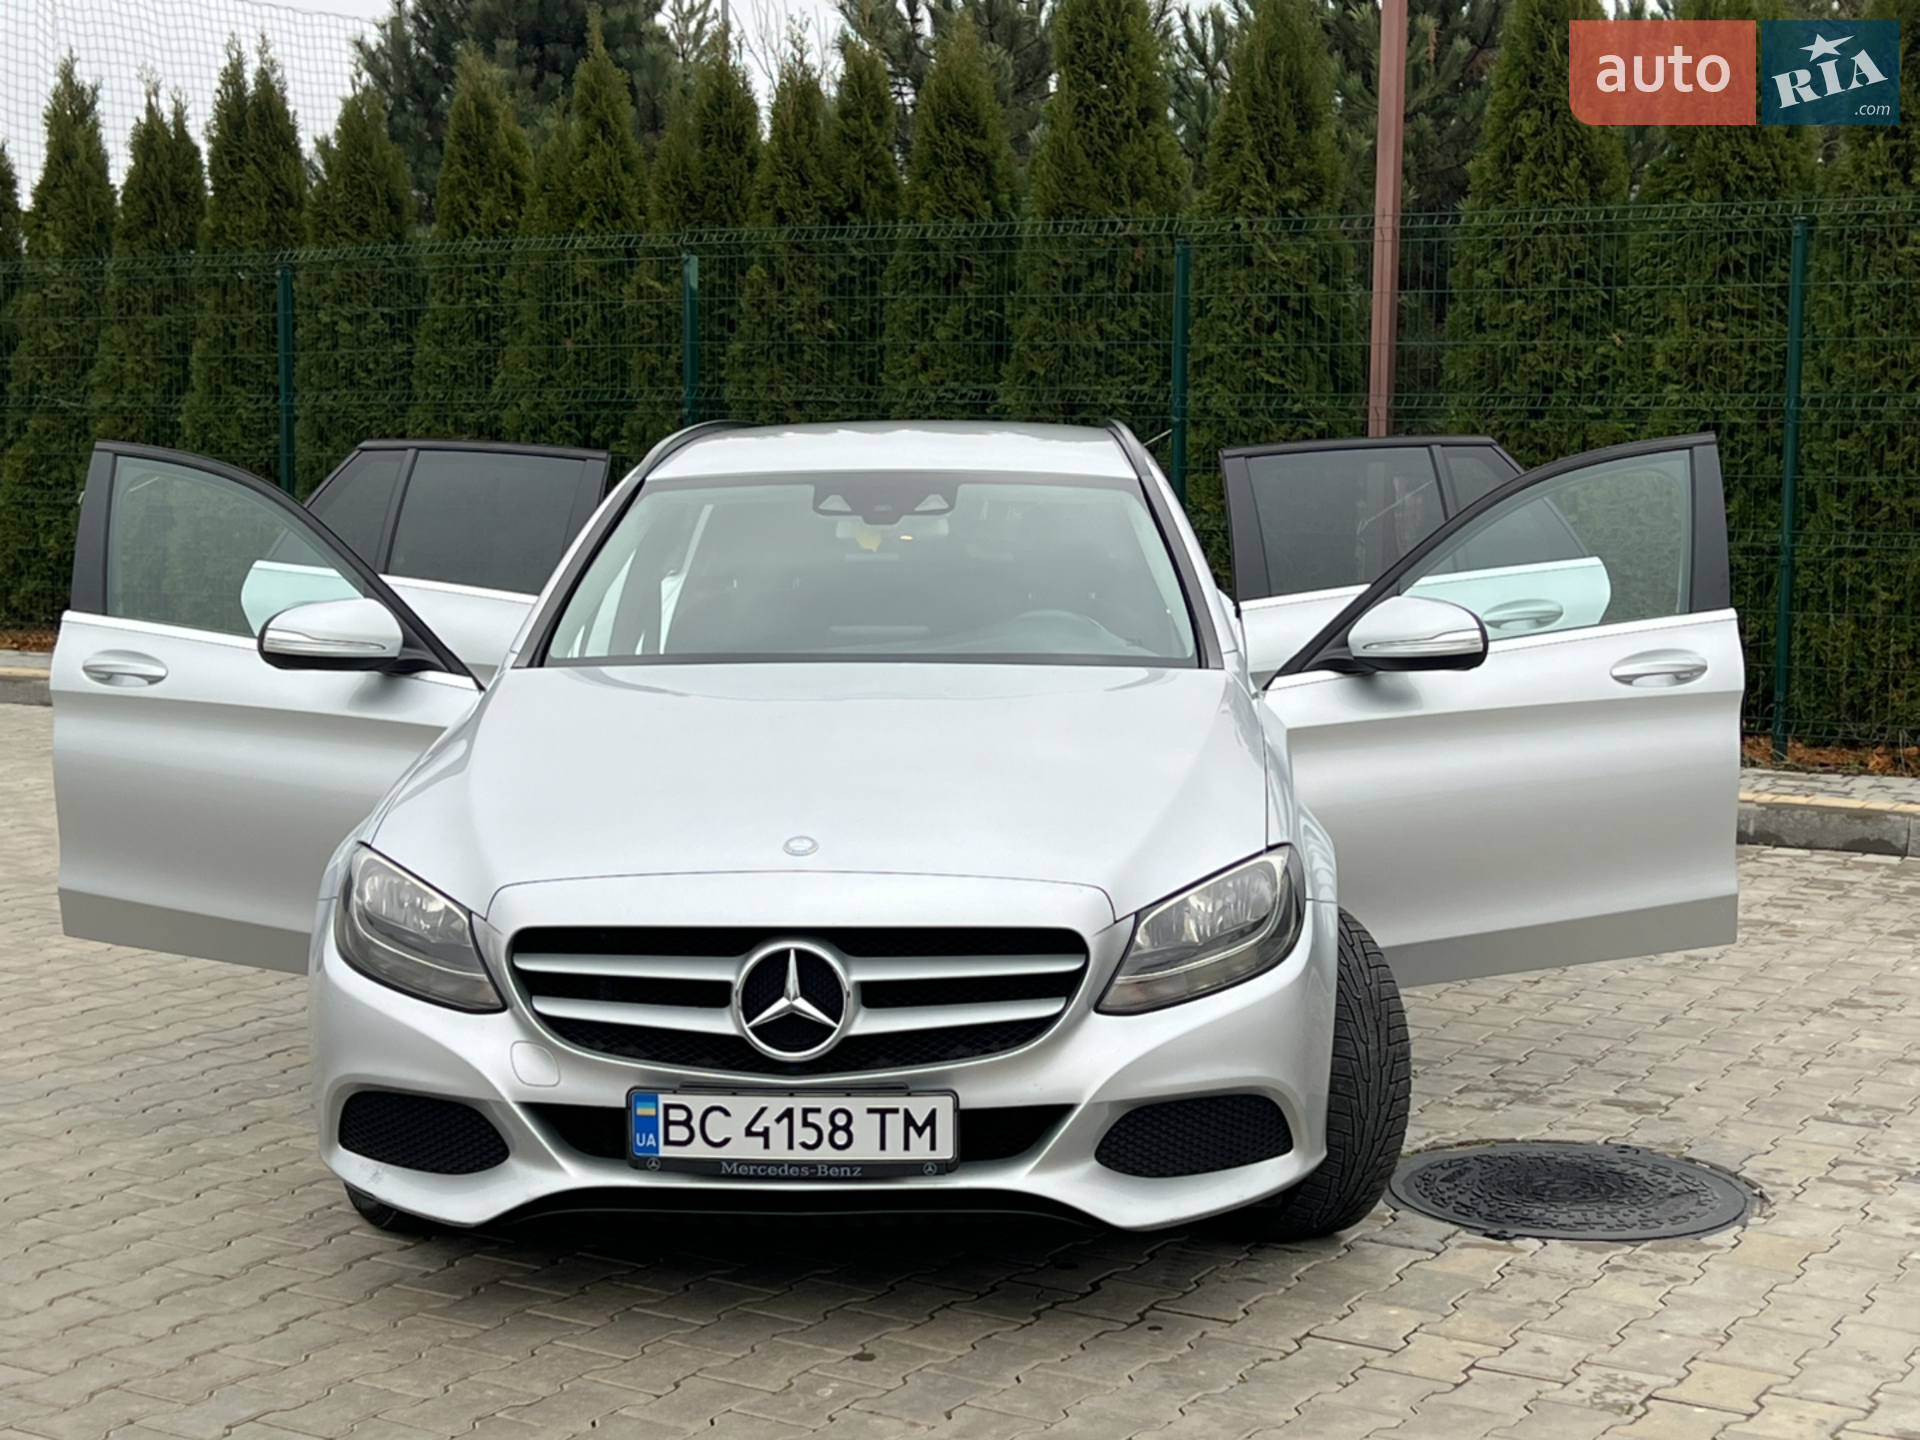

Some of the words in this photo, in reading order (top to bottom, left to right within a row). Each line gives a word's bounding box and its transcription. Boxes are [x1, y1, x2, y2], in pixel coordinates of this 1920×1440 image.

[662, 1103, 732, 1149] BC
[744, 1105, 854, 1151] 4158
[866, 1107, 937, 1152] TM
[636, 1133, 656, 1148] UA
[720, 1161, 863, 1177] Mercedes-Benz
